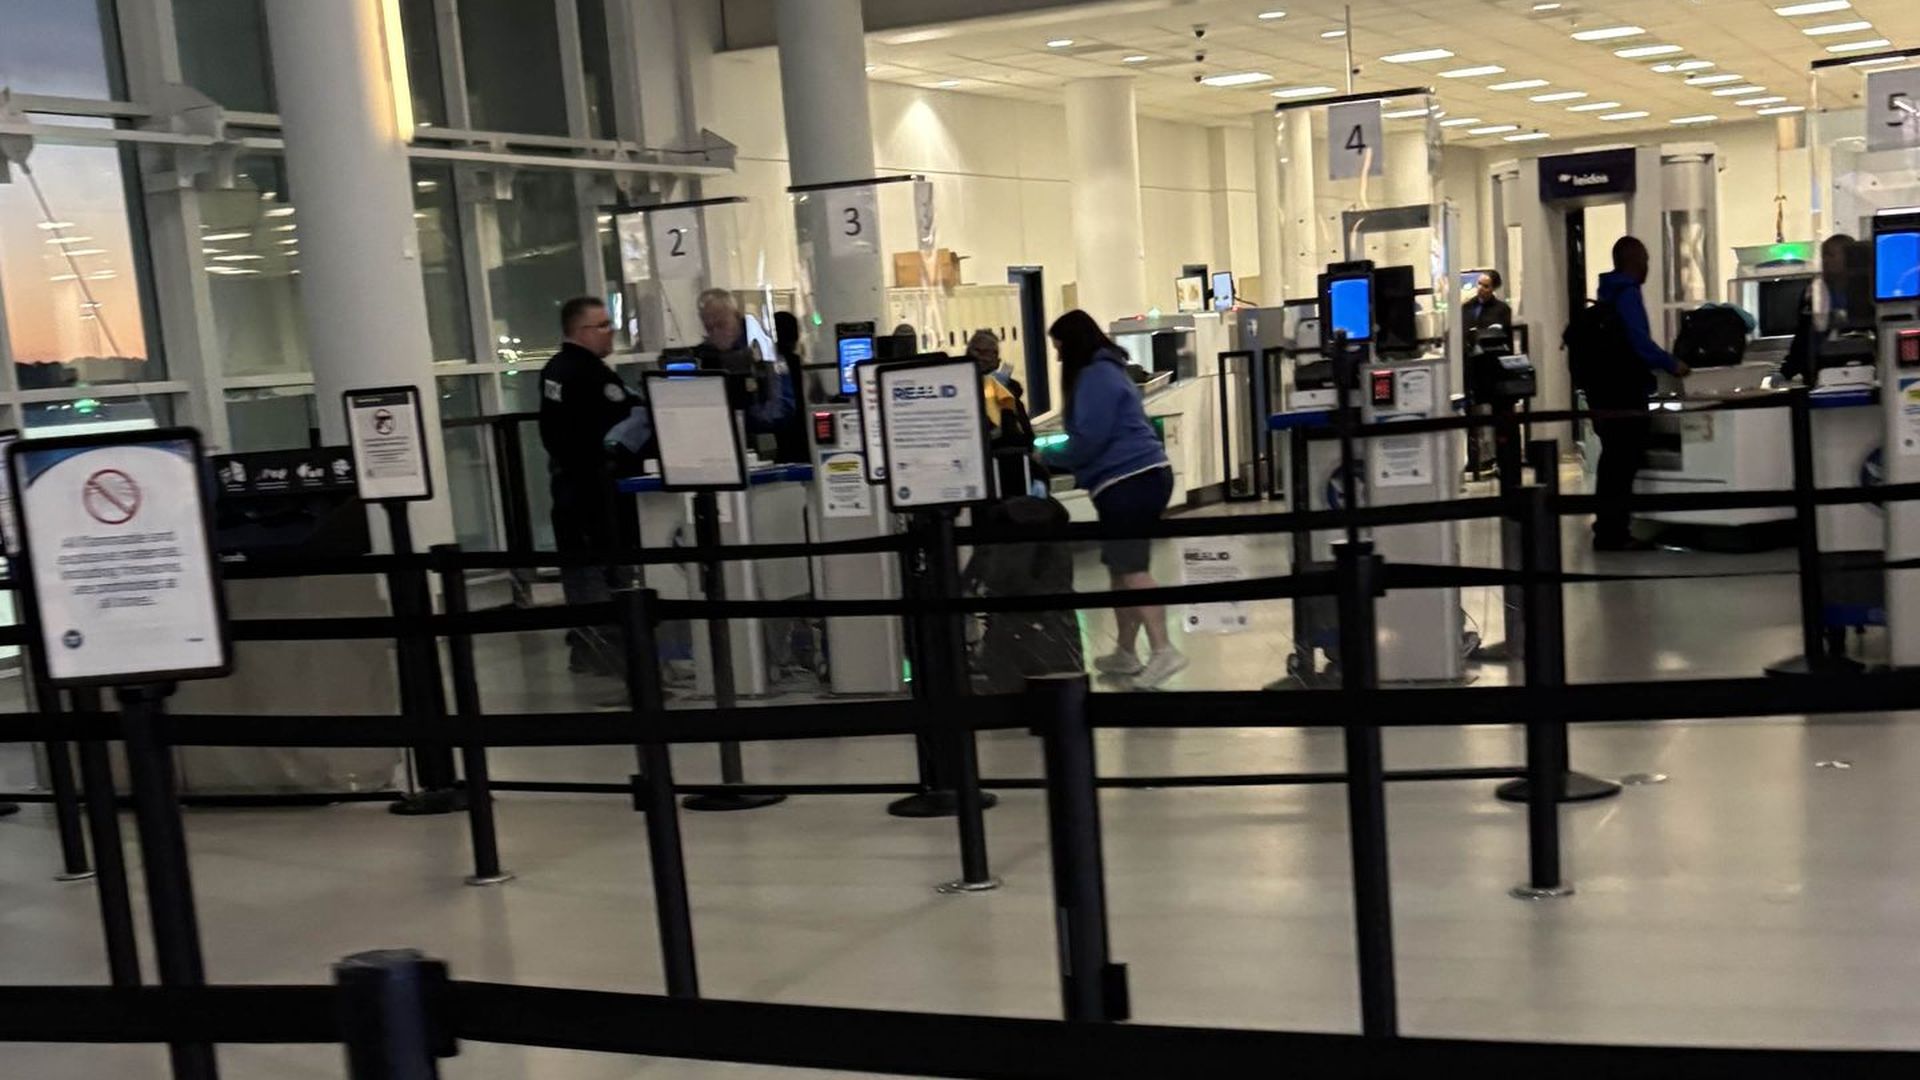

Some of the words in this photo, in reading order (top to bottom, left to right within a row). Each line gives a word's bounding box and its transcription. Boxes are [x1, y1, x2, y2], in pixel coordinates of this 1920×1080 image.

[1886, 92, 1908, 127] 5
[1344, 123, 1366, 155] 4
[1572, 173, 1609, 187] leidos
[843, 207, 862, 236] 3
[667, 228, 686, 257] 2
[892, 387, 939, 400] REAL
[940, 385, 957, 398] ID
